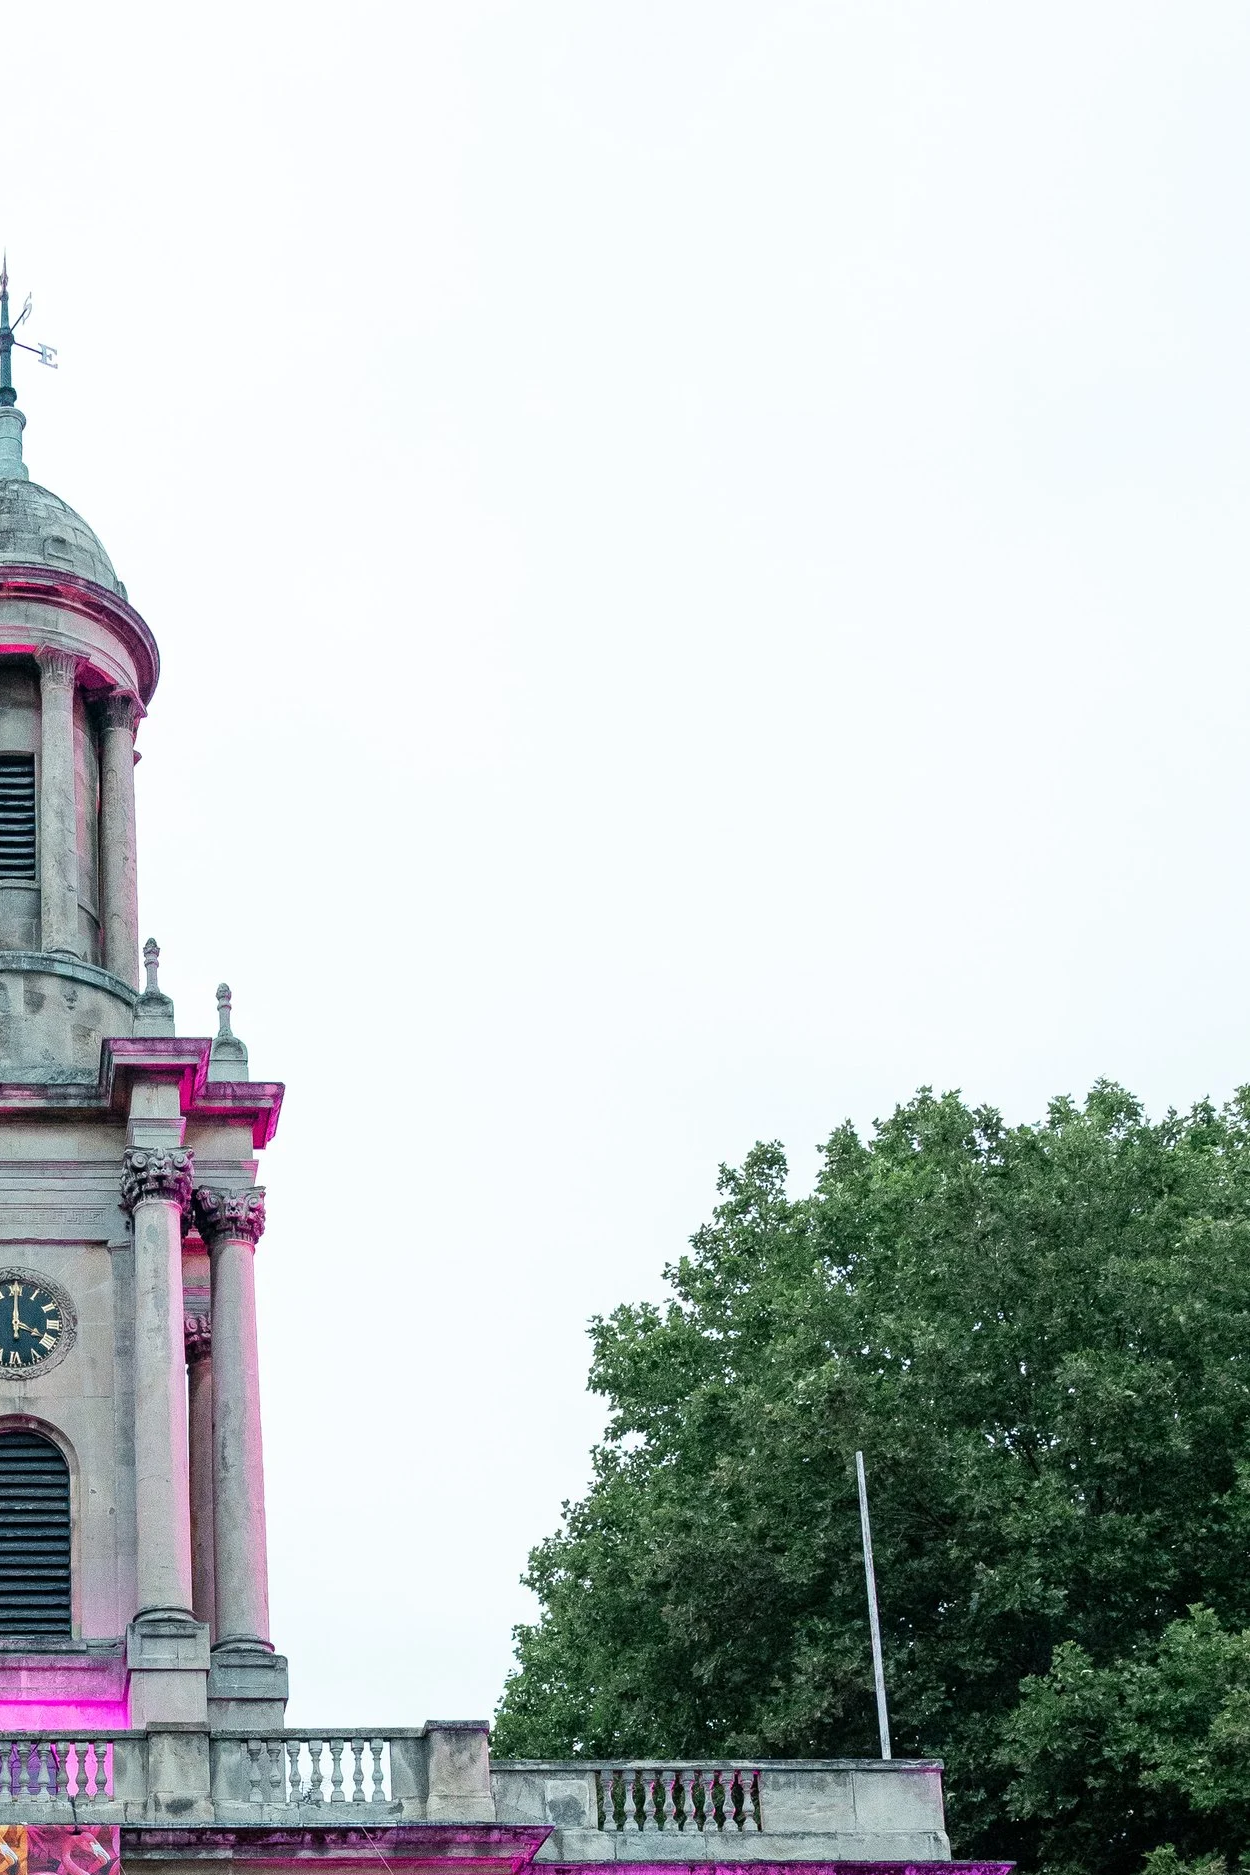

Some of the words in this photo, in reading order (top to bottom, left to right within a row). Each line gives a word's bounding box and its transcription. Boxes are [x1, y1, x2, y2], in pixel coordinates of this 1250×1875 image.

[37, 342, 58, 369] E
[30, 1288, 40, 1301] I
[41, 1302, 57, 1313] II
[46, 1319, 60, 1328] III
[9, 1351, 22, 1364] VI
[30, 1348, 42, 1361] V
